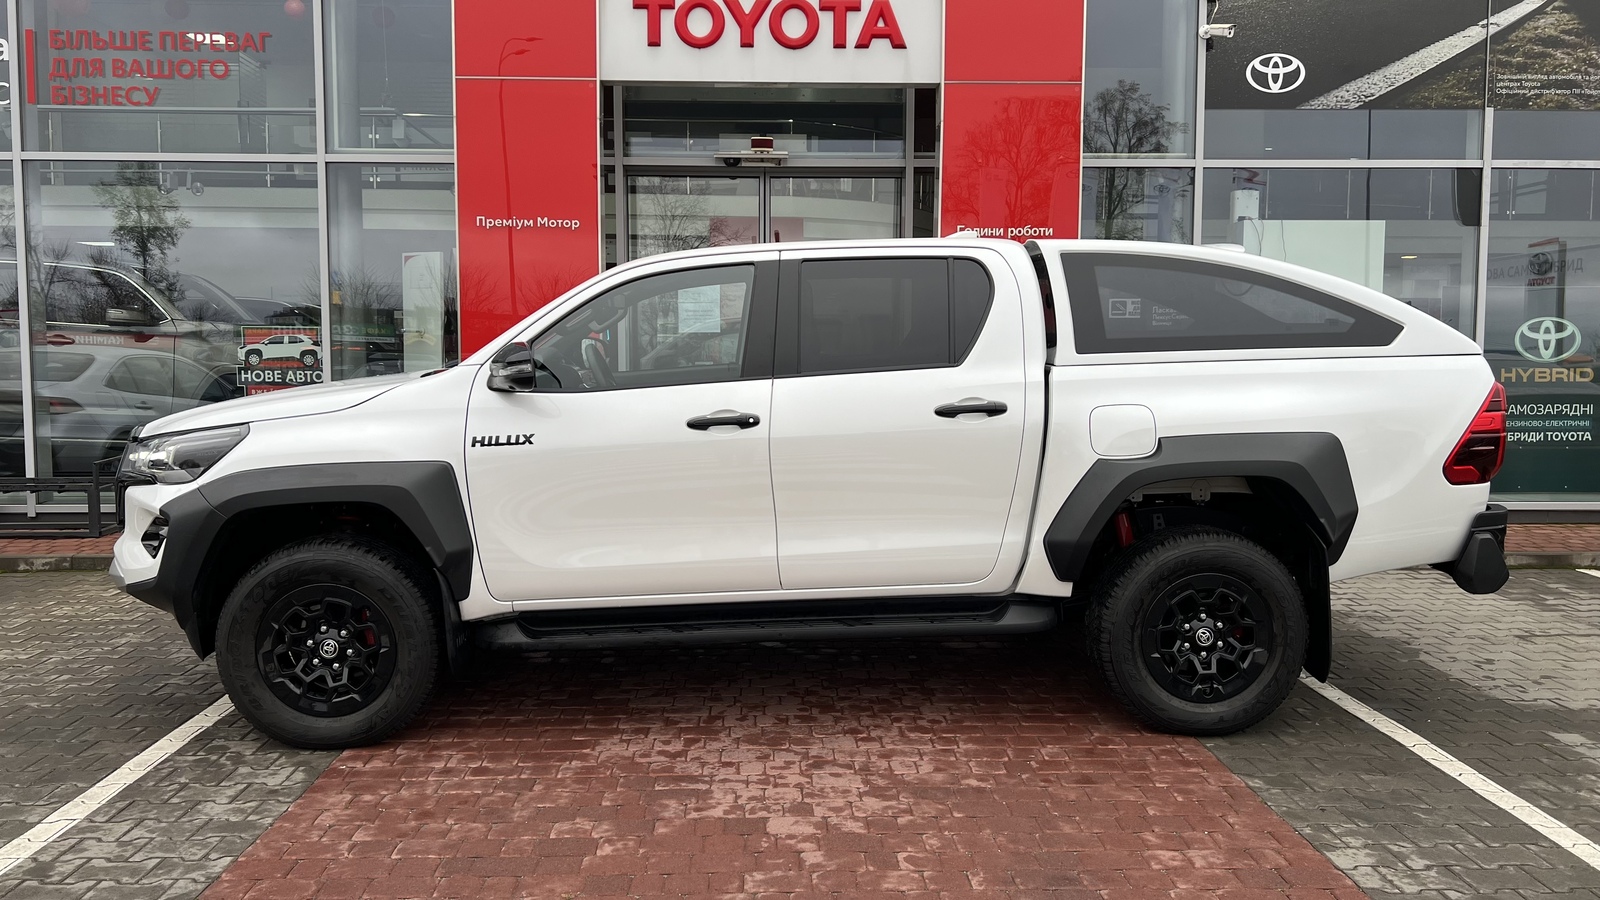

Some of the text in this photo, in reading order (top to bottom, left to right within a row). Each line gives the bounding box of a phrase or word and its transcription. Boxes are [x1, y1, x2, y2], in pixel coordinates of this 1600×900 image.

[633, 0, 907, 49] TOYOTA
[49, 29, 271, 52] БІЛЬШЕ ПЕРЕВАГ
[49, 57, 231, 81] ДЛЯ ВАШОГО
[1521, 80, 1540, 88] Toyota
[51, 85, 160, 106] БІЗНЕСУ
[476, 216, 580, 230] Преміум Мотор
[1008, 225, 1053, 238] роботи
[241, 370, 323, 383] НОВЕ АВТО
[1500, 367, 1595, 383] HYBRID
[1505, 404, 1594, 416] АМОЗАРЯДНІ
[471, 433, 535, 448] HILUX
[1507, 431, 1592, 442] БРИДИ TOYOTA
